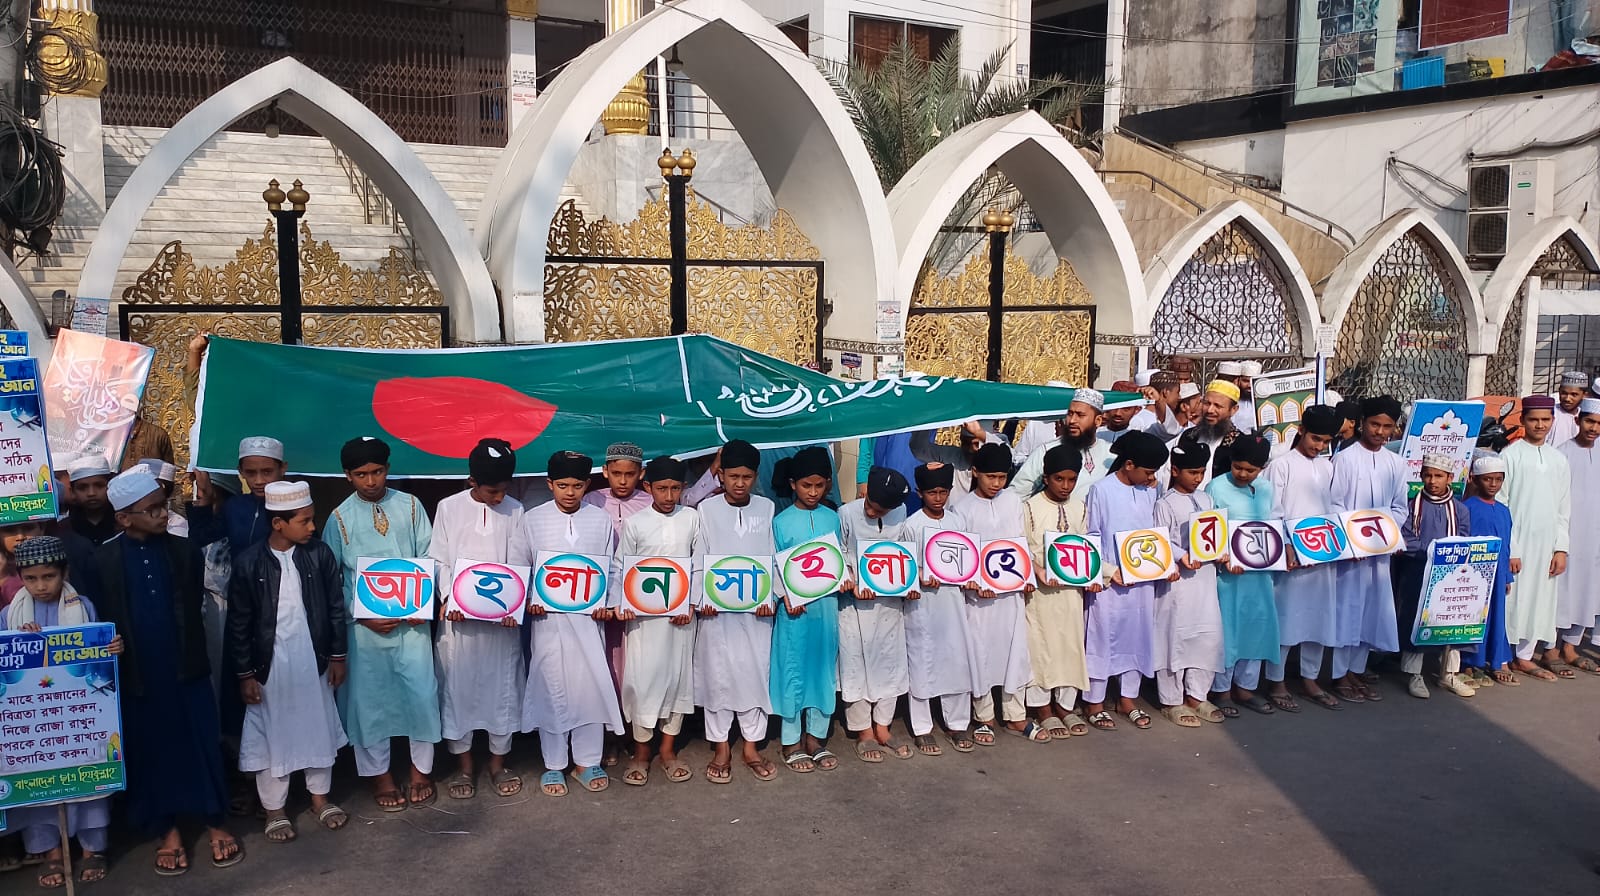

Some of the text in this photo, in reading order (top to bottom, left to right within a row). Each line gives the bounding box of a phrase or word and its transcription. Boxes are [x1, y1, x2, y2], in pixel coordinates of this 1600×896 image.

[1420, 432, 1464, 443] এসো নবীন
[4, 451, 33, 467] সঠিক
[1198, 516, 1218, 552] র
[1237, 526, 1272, 566] ম
[1293, 521, 1340, 551] জা
[1351, 516, 1389, 546] ন
[791, 547, 837, 579] হ
[863, 551, 911, 585] লা
[935, 540, 969, 576] ন
[985, 548, 1025, 581] হে
[1052, 541, 1093, 581] মা
[1125, 535, 1167, 571] হে
[360, 569, 431, 609] আ
[471, 570, 513, 612] হ
[543, 566, 601, 602] লা
[634, 566, 677, 610] ন
[710, 565, 765, 602] সা
[12, 638, 43, 654] দিয়ে
[48, 632, 84, 647] মাহে
[8, 689, 87, 705] মাহে রমজানের
[0, 709, 36, 722] বিত্রতা
[40, 706, 63, 717] রক্ষা
[3, 717, 95, 737] নিজে রোজা রাখুন
[40, 735, 69, 747] রোজা
[73, 731, 108, 743] রাখতে
[6, 751, 56, 766] উৎসাহিত
[15, 775, 55, 791] বাংলাদেশ
